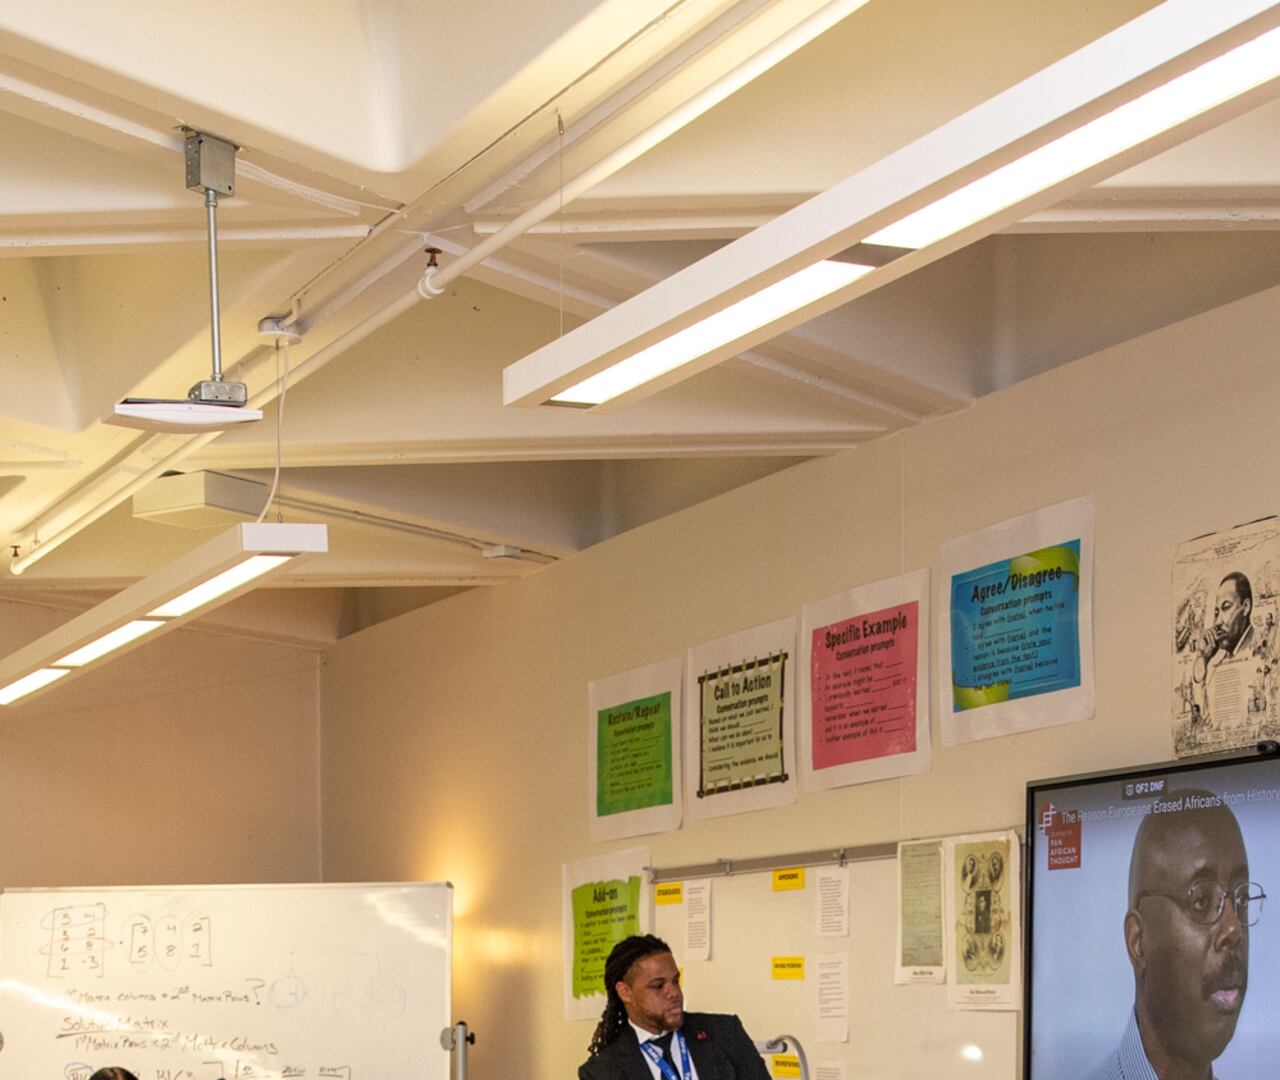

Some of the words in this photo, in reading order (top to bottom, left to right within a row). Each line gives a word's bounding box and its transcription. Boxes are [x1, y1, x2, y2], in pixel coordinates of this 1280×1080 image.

[972, 566, 1062, 603] Agree/Disagree
[980, 598, 1020, 617] Conversation
[1023, 590, 1052, 606] prompts
[826, 624, 860, 650] Specific
[863, 612, 907, 638] Example
[714, 682, 730, 700] Call
[732, 681, 740, 696] to
[742, 675, 771, 694] Action
[1062, 812, 1076, 824] The
[1077, 808, 1107, 821] Reason
[1109, 803, 1152, 820] Europeans
[1154, 800, 1182, 814] Erased
[1184, 795, 1222, 810] Africans
[1223, 791, 1245, 804] from
[1247, 788, 1280, 801] History
